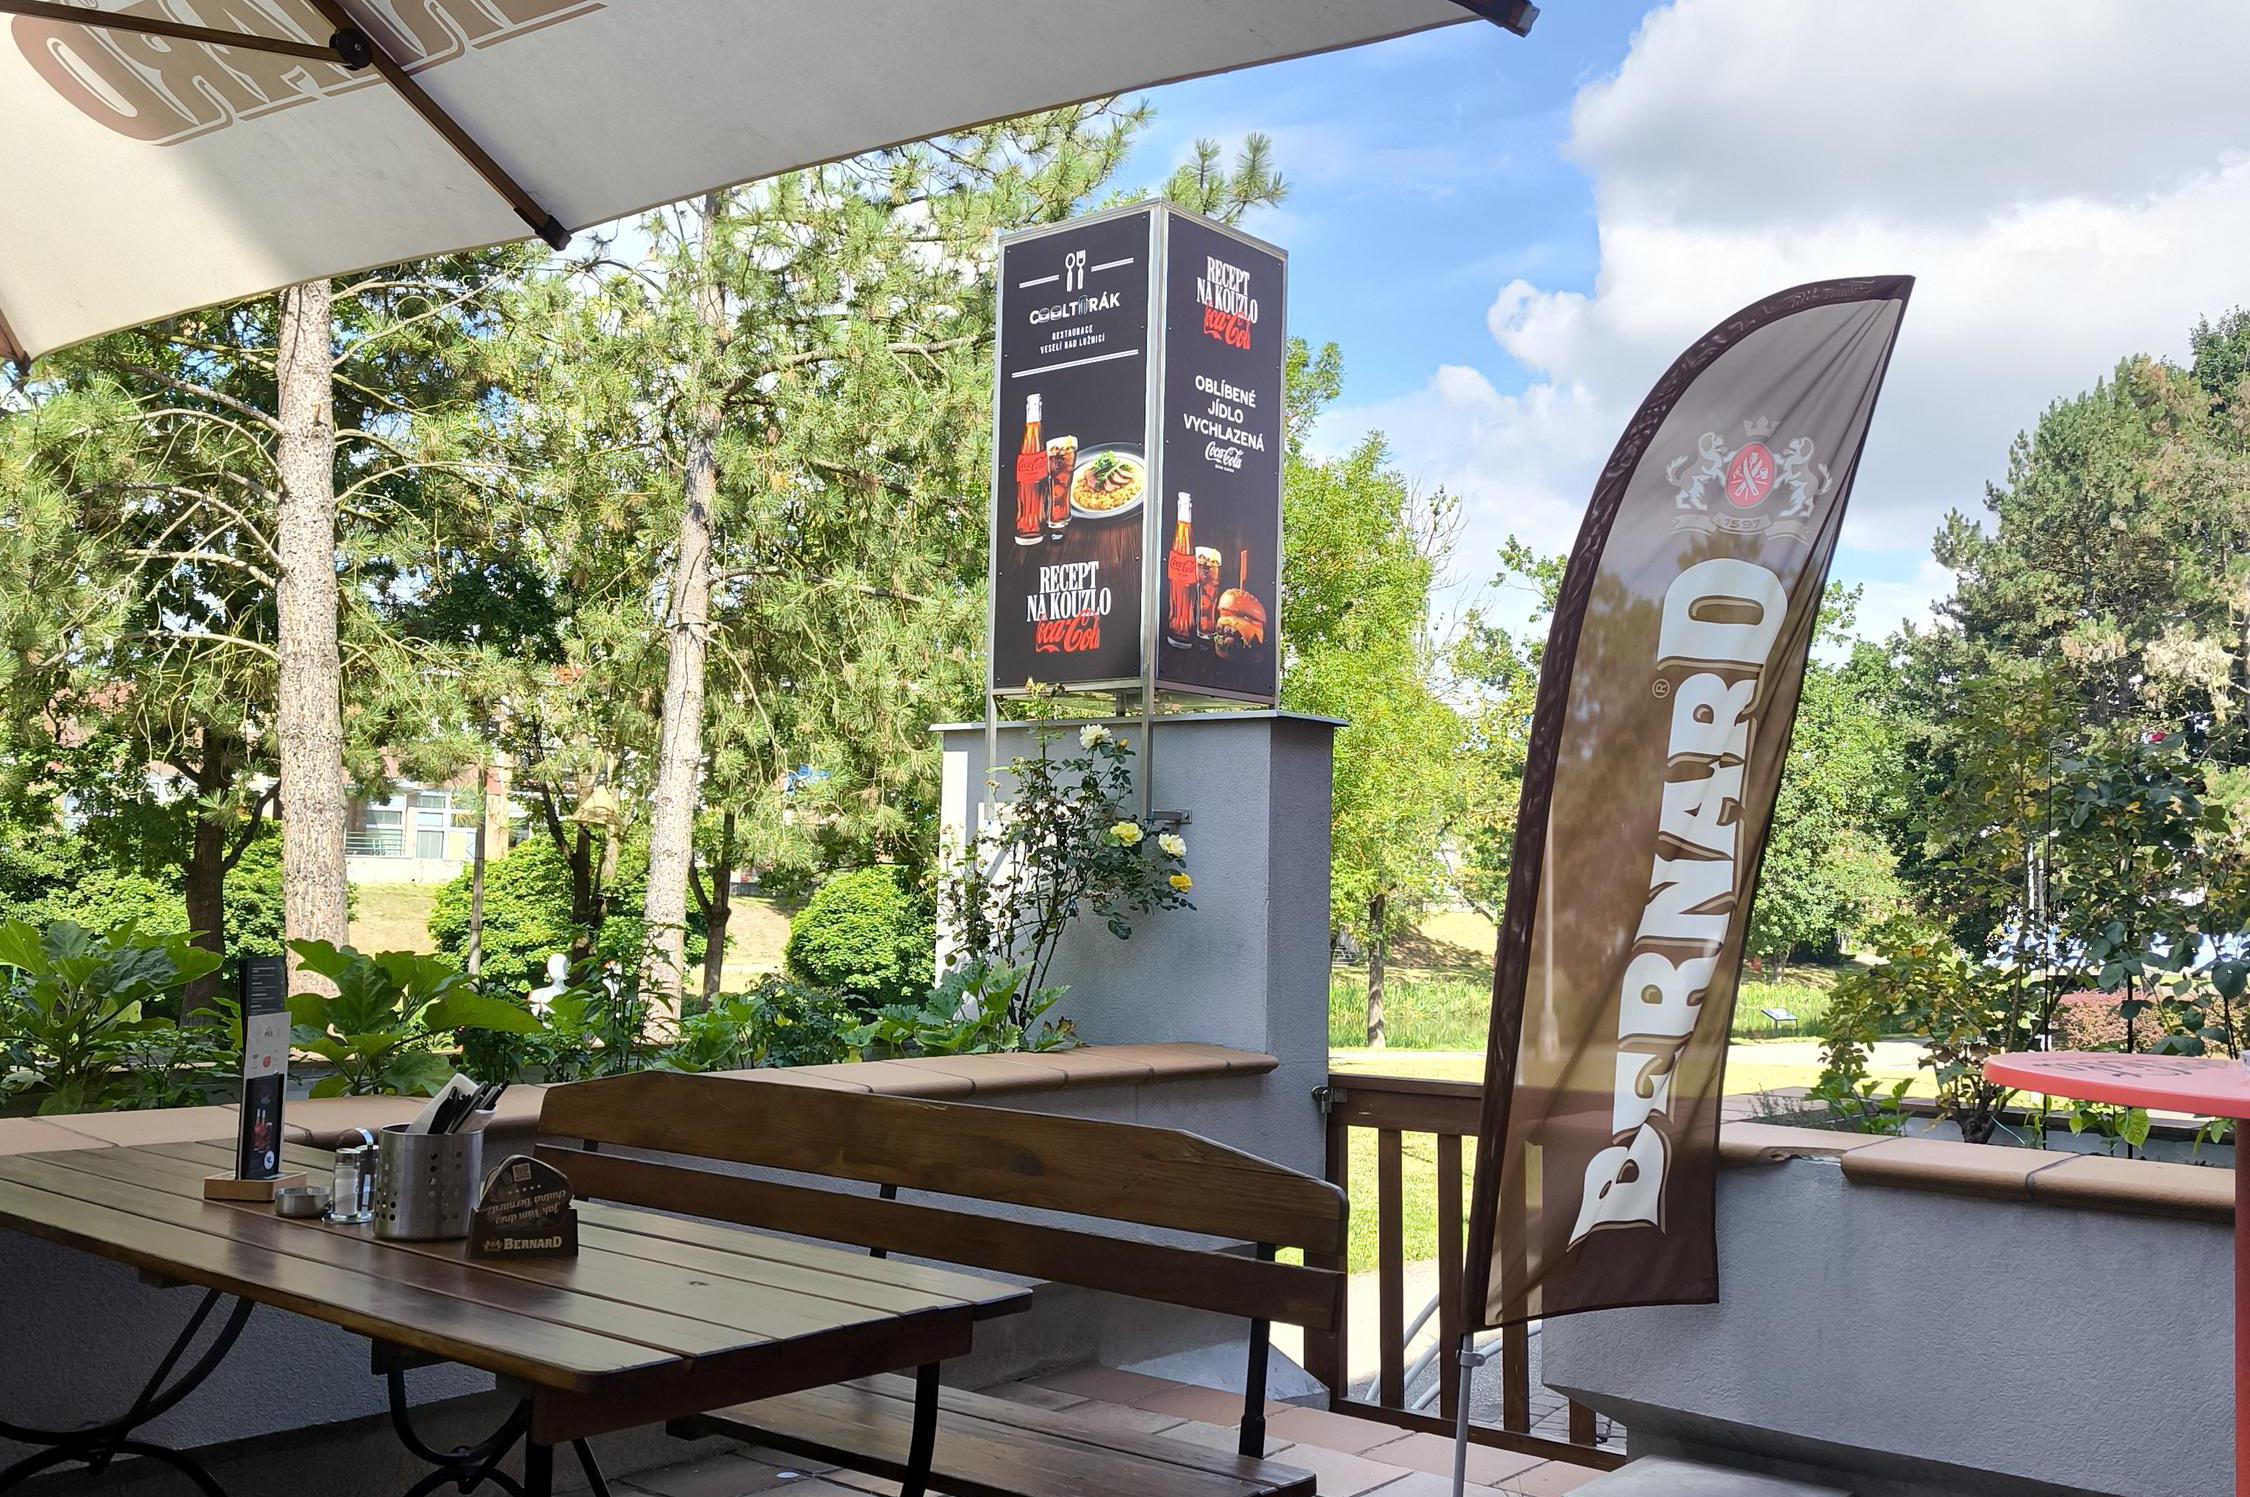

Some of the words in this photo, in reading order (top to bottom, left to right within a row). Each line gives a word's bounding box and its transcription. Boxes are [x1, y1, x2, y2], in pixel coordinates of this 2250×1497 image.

[1207, 255, 1250, 296] RECEPT
[1196, 276, 1214, 308] NA
[1215, 284, 1259, 324] KOUZLO
[1051, 324, 1094, 341] RESTAURACE
[1064, 339, 1078, 350] NAD
[1195, 374, 1257, 409] OBLÍBENÉ
[1207, 398, 1244, 424] JÍDLO
[1183, 413, 1265, 453] VYCHLAZENÁ
[1724, 517, 1761, 530] 1597
[1039, 560, 1100, 594] RECEPT
[1026, 594, 1048, 622] NA
[1049, 587, 1112, 621] KOUZLO
[1565, 557, 1789, 1254] BERNARD
[503, 1235, 562, 1250] BERNARD
